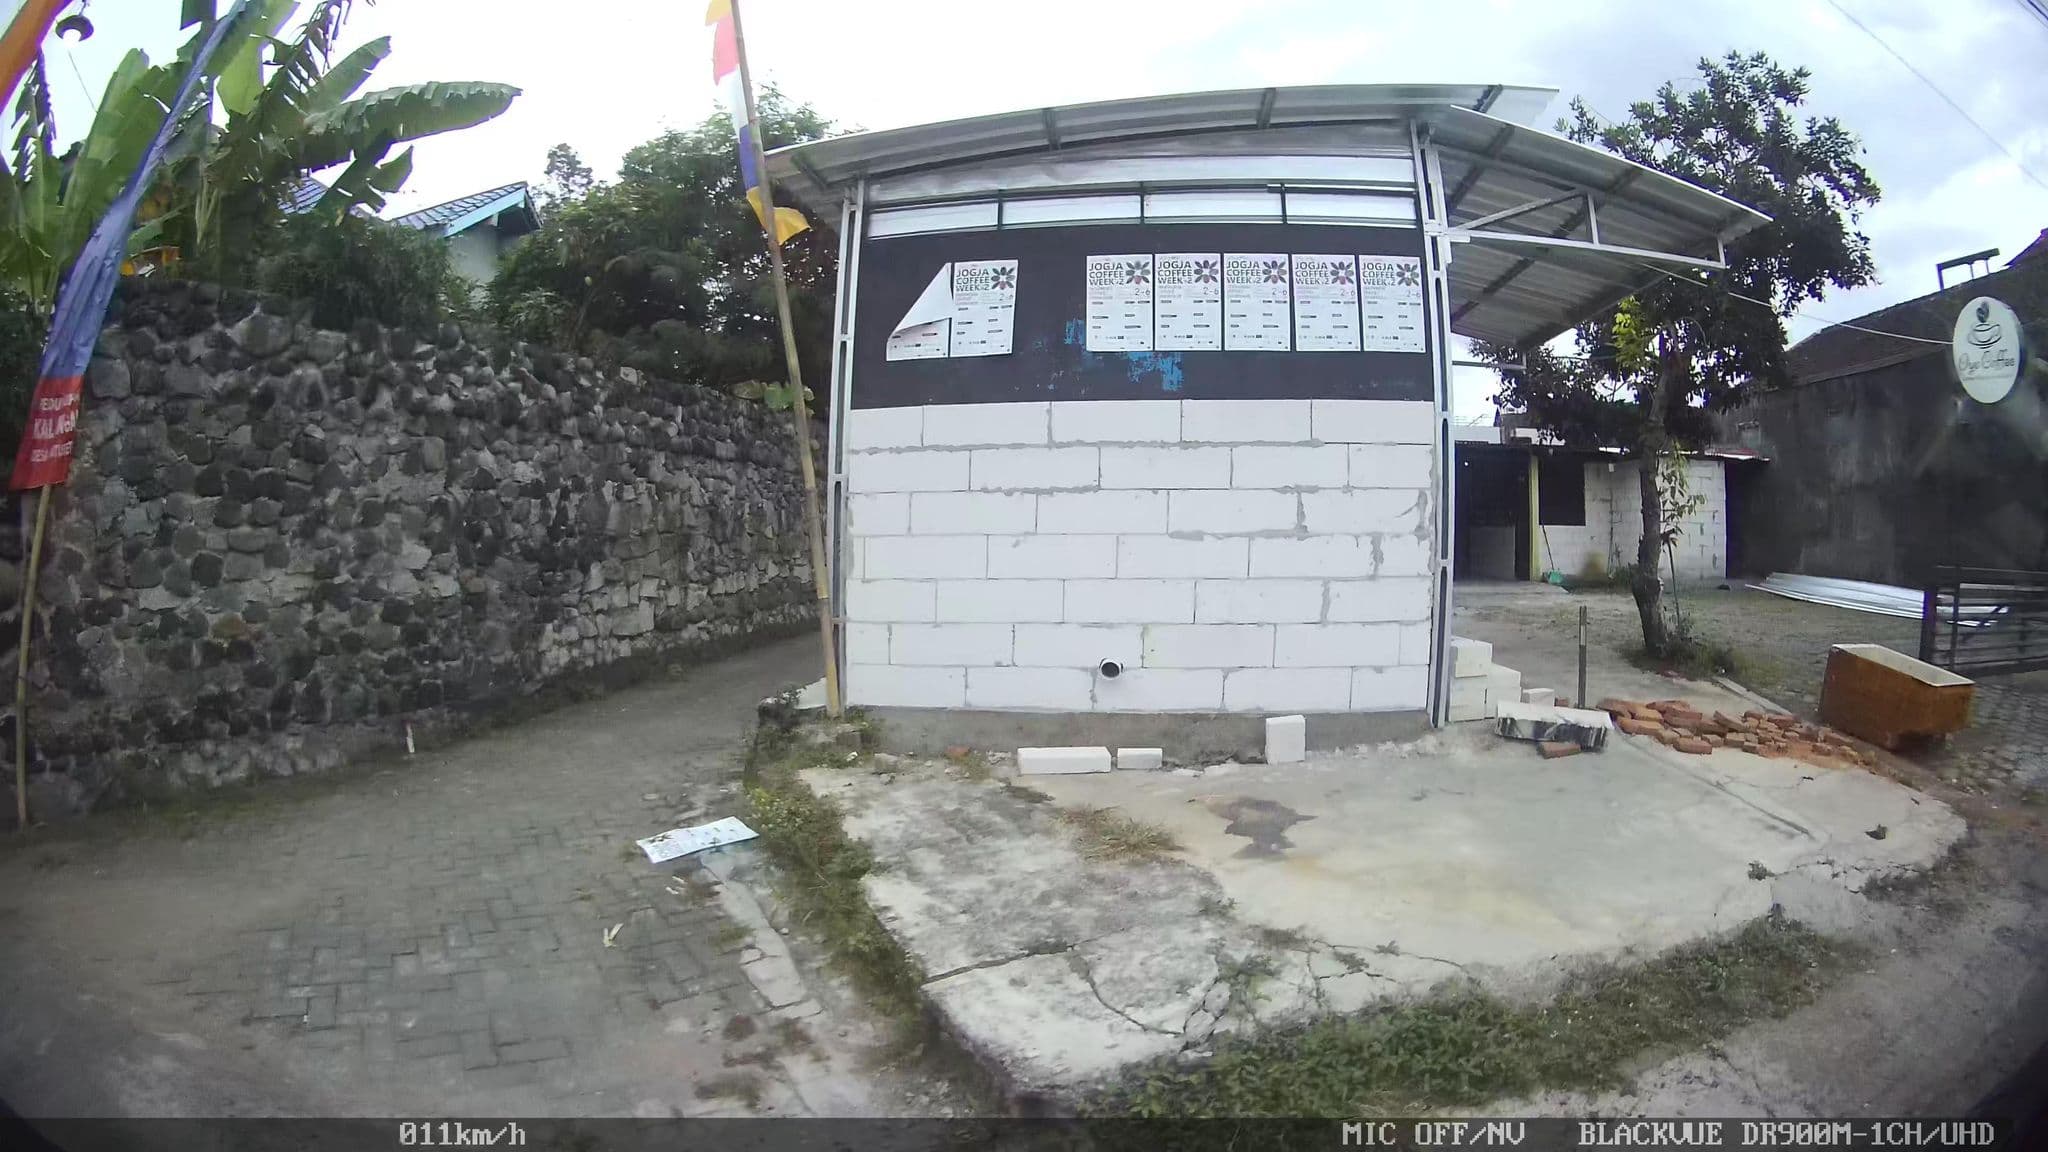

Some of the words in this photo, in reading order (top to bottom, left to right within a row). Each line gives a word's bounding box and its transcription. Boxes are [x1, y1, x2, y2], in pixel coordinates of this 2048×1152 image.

[1089, 262, 1123, 271] JOGJA
[1158, 260, 1192, 269] JOGJA
[1226, 260, 1260, 269] JOGJA
[1295, 261, 1328, 270] JOGJA
[1362, 262, 1394, 271] JOGJA
[956, 268, 989, 277] JOGJA
[1089, 271, 1124, 279] COFFEE
[1158, 269, 1192, 277] COFFEE
[1226, 269, 1261, 277] COFFEE
[1295, 270, 1329, 278] COFFEE
[1362, 271, 1395, 279] COFFEE
[956, 277, 990, 285] COFFEE
